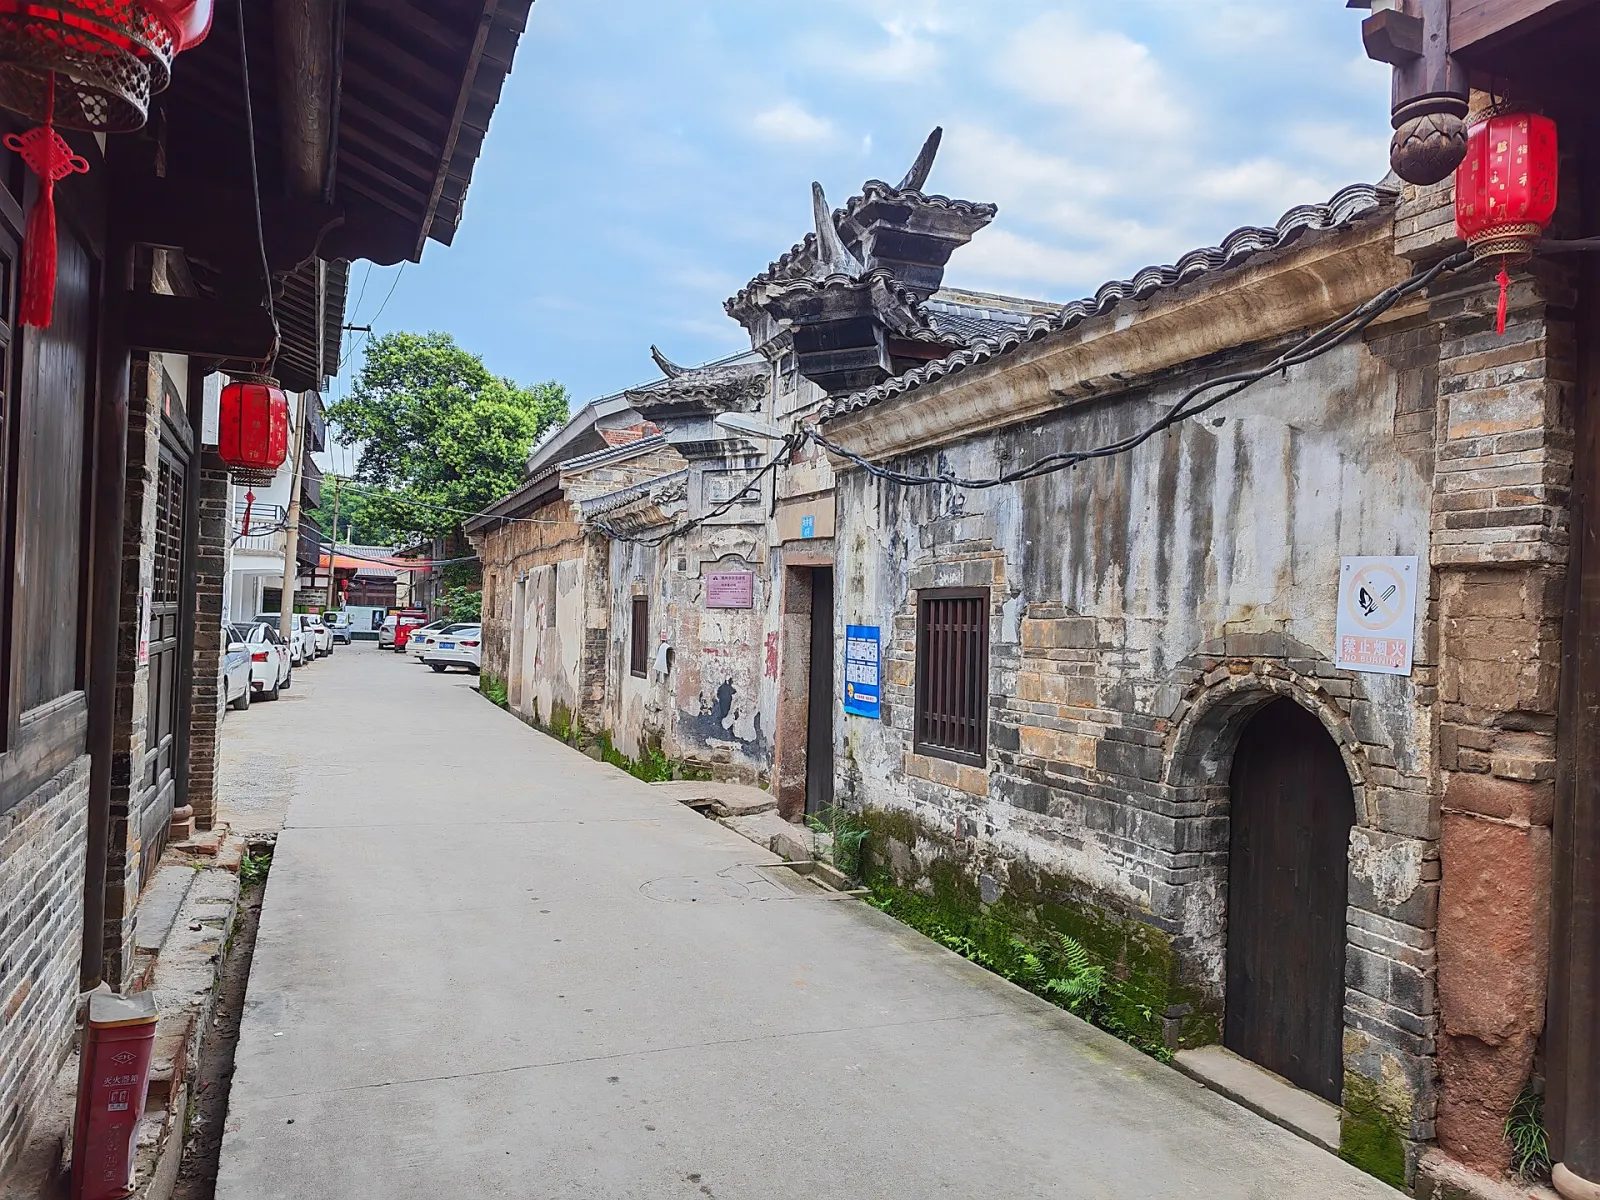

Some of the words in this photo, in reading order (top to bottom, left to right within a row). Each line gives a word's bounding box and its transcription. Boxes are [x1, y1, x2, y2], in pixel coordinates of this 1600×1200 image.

[1343, 637, 1404, 657] 禁止烟火
[1360, 655, 1403, 665] BURNING
[103, 1074, 139, 1084] 灭火器箱
